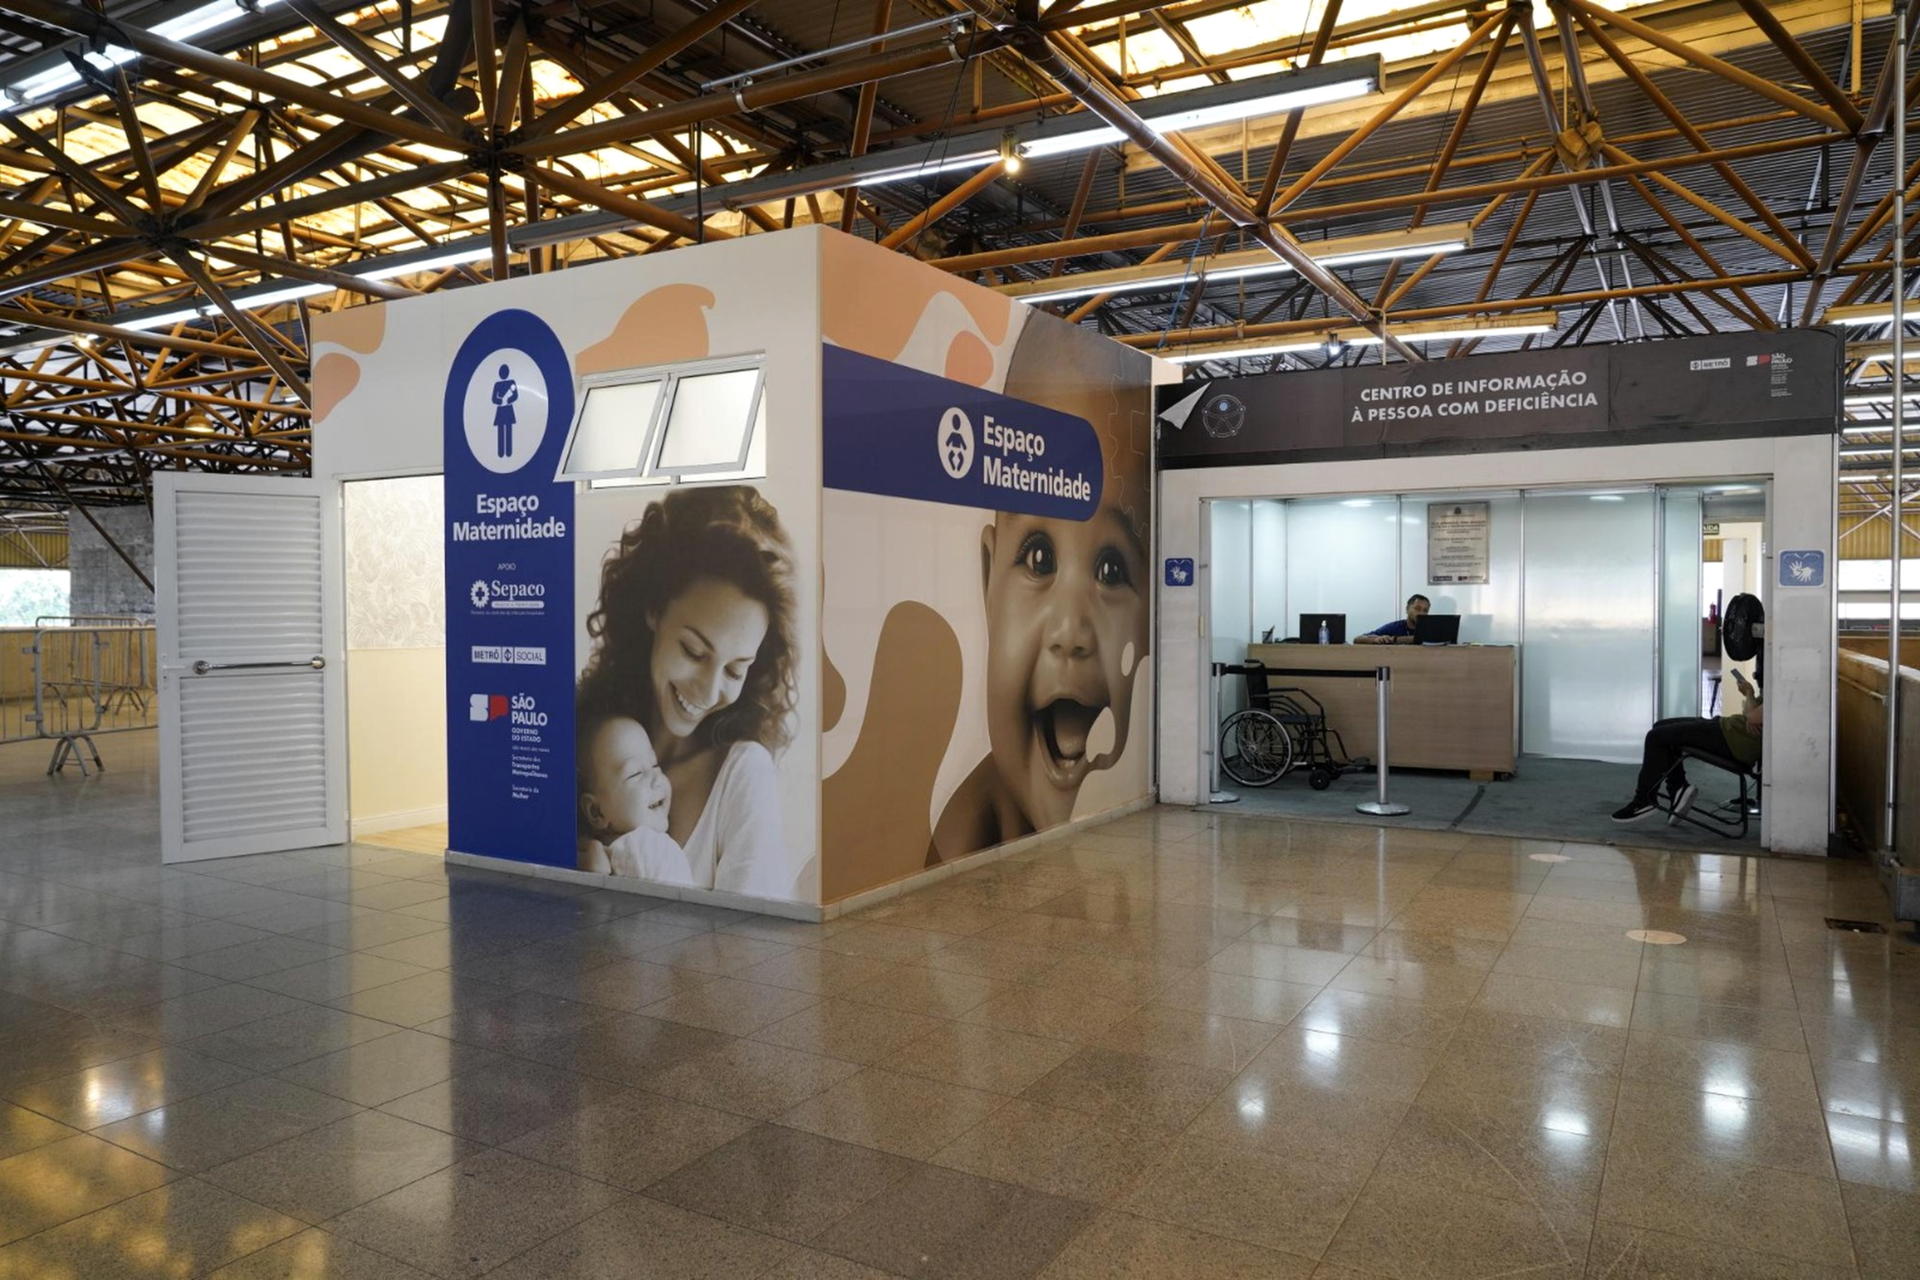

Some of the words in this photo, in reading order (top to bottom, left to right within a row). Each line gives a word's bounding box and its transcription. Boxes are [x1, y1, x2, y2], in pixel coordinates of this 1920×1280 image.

[1360, 384, 1427, 401] CENTRO
[1432, 382, 1453, 396] DE
[1458, 369, 1587, 394] INFORMAÇÃO
[1351, 406, 1363, 422] À
[1368, 404, 1433, 421] PESSOA
[1437, 401, 1479, 416] COM
[1485, 391, 1598, 413] DEFICIÊNCIA
[983, 415, 1045, 462] Espaço
[983, 455, 1091, 502] Maternidade
[476, 493, 540, 518] Espaço
[453, 516, 566, 541] Maternidade
[497, 562, 517, 571] APOIO
[491, 579, 546, 601] Sepaco
[474, 648, 500, 661] METRÔ
[516, 650, 544, 662] SOCIAL
[511, 692, 536, 710] SÃO
[511, 711, 548, 726] PAULO
[511, 727, 539, 735] GOVERNO
[521, 735, 542, 743] ESTADO
